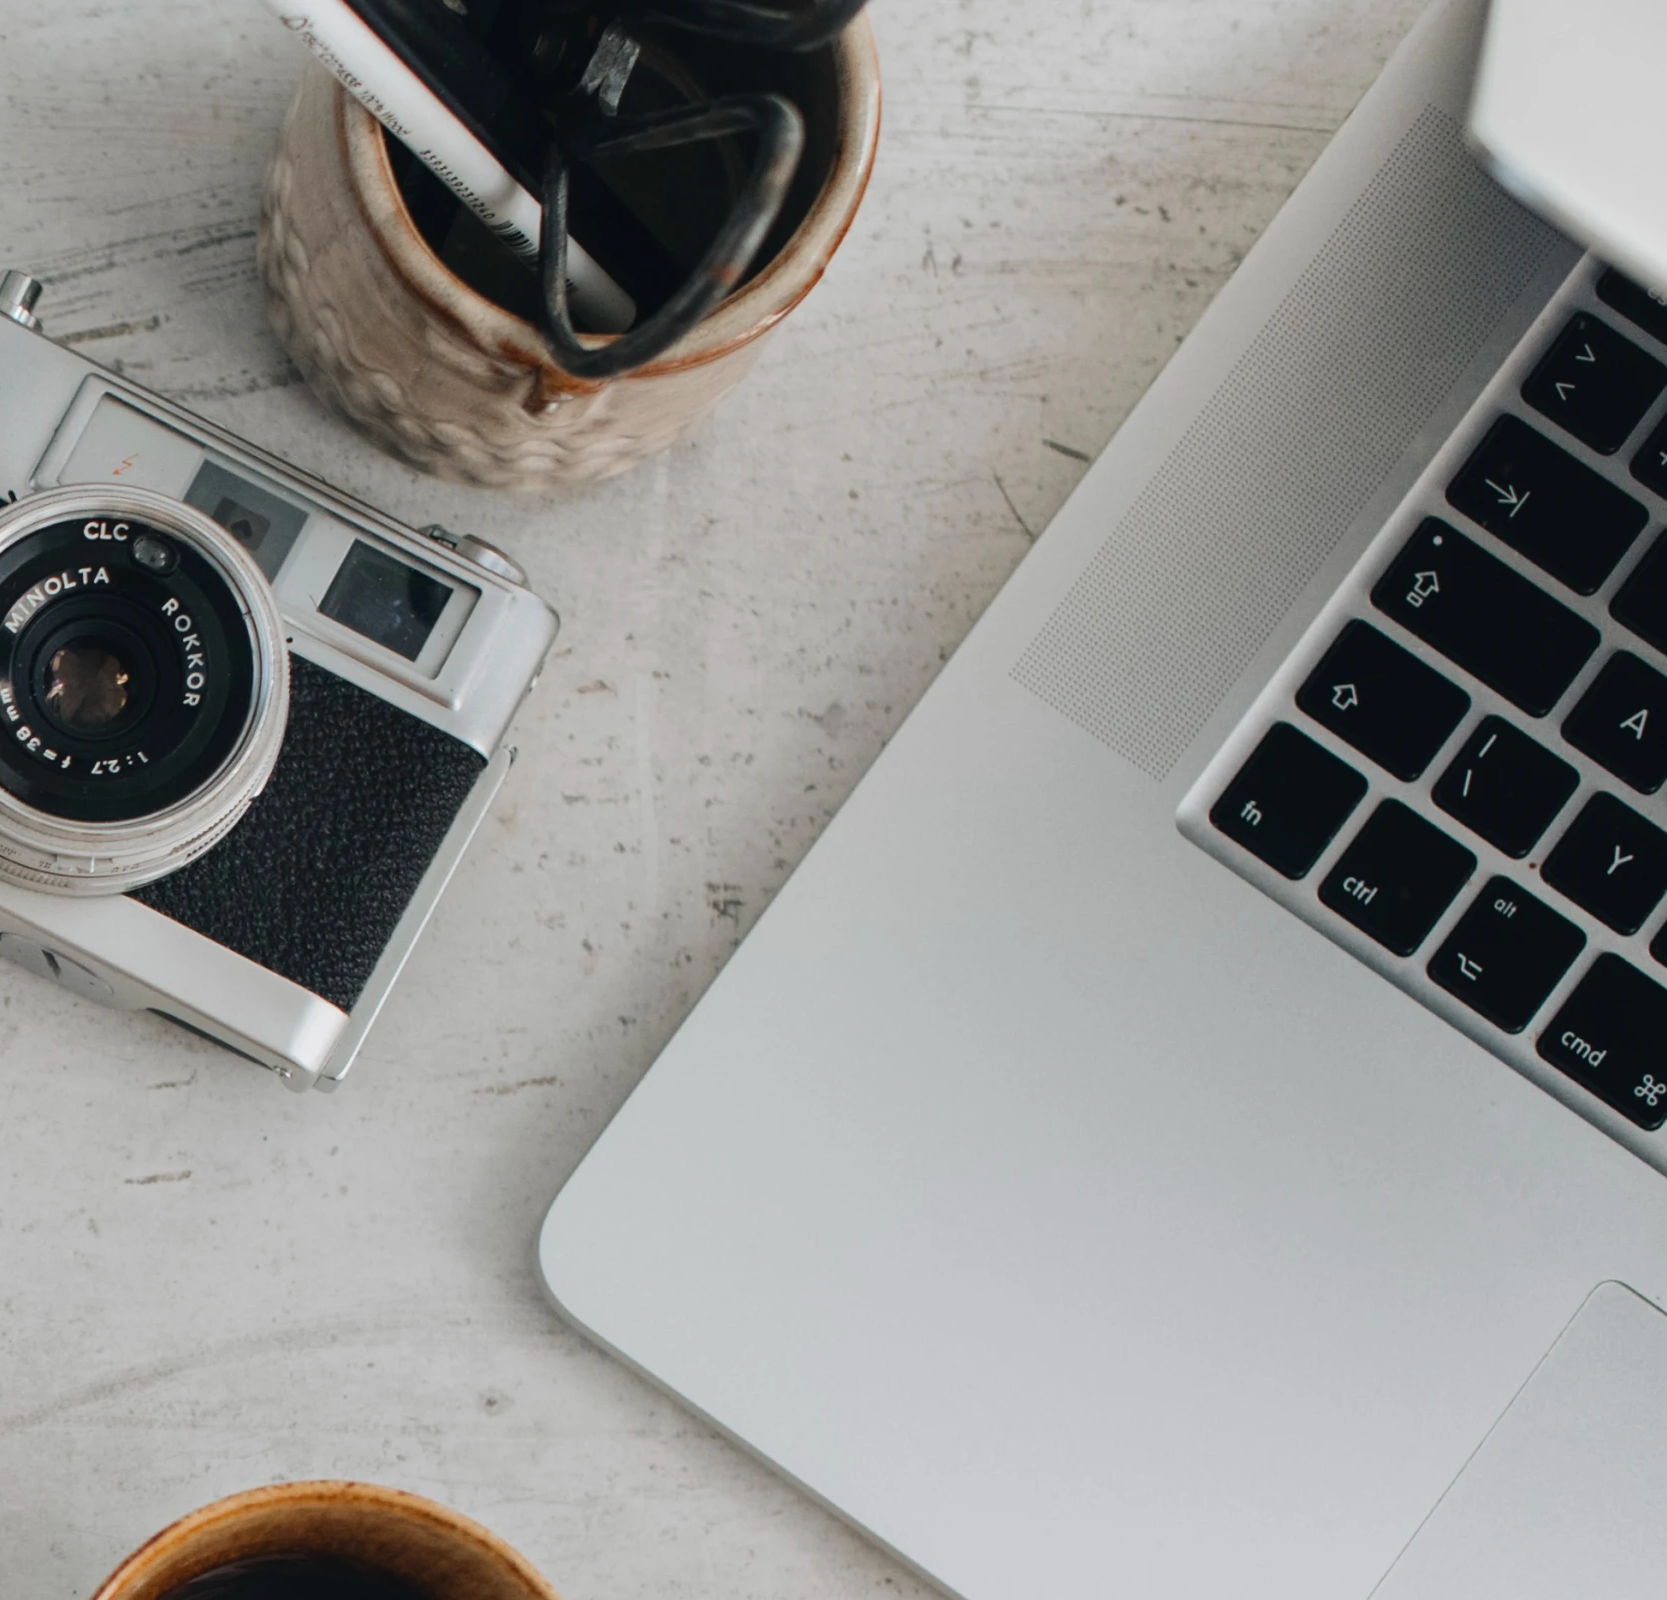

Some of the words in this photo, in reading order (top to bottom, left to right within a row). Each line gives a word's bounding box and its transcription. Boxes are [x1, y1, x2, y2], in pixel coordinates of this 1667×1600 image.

[83, 521, 129, 541] CLC
[5, 566, 110, 634] MINOLTA
[161, 598, 205, 707] ROKKOR
[1620, 709, 1648, 740] A
[1240, 800, 1263, 827] fn
[1607, 845, 1634, 875] Y
[1342, 876, 1378, 906] ctrl
[1494, 899, 1517, 919] alt
[1561, 1031, 1607, 1068] cmd
